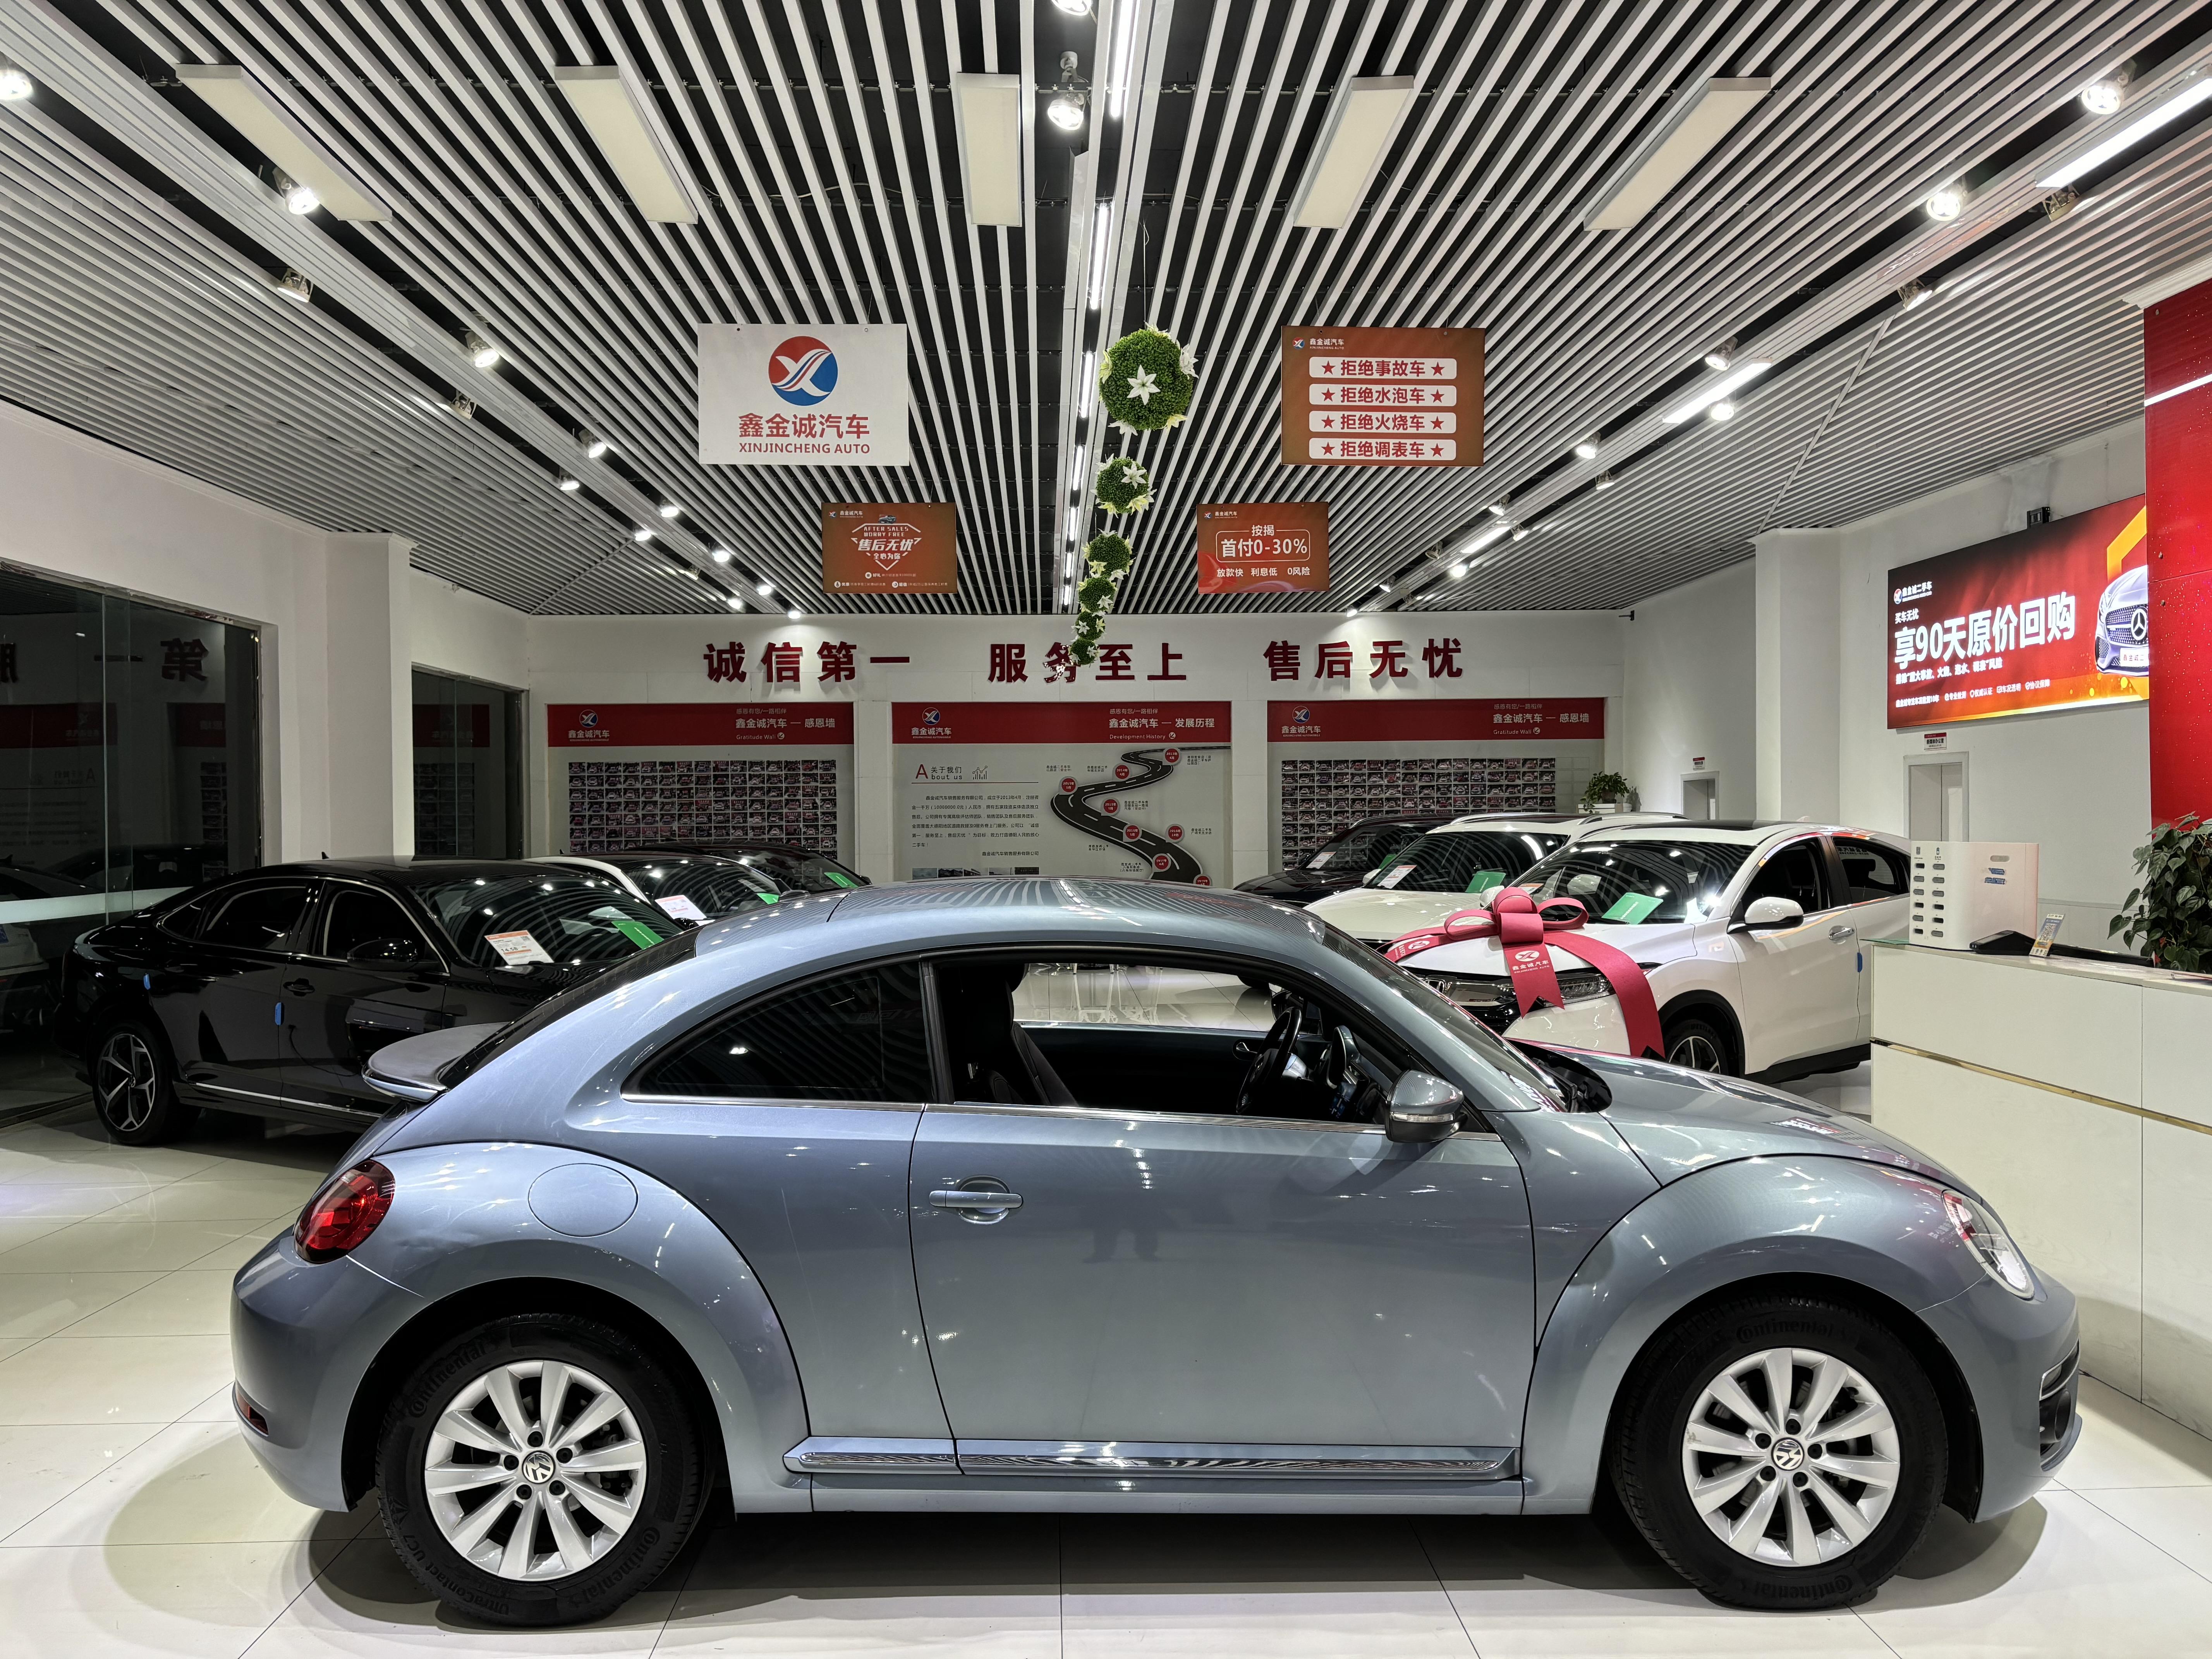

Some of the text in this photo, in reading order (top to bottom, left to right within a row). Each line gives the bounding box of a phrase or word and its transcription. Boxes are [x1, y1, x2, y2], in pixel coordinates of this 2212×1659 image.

[1341, 359, 1425, 377] 拒绝事故车
[1341, 387, 1425, 404] 拒绝水泡车
[738, 412, 870, 439] 鑫金诚汽车
[1341, 414, 1425, 431] 拒绝火烧车
[739, 443, 870, 454] XINJINCHENG AUTO
[1341, 441, 1425, 458] 拒绝调表车
[1252, 525, 1274, 536] 按揭
[858, 539, 914, 551] 售后无忧
[1221, 538, 1307, 557] 首付0-30%
[1217, 567, 1310, 577] 放款快 利息低 0风险
[1895, 608, 1919, 624] 买车无忧
[1894, 591, 2075, 670] 享90天原价回购
[703, 638, 1462, 683] 诚信第一 服务至上 售后无忧
[735, 718, 787, 728] 鑫金诚汽车
[805, 718, 835, 728] 感恩墙
[1109, 718, 1158, 728] 鑫金诚汽车
[1175, 718, 1214, 728] 发展历程
[1493, 713, 1543, 723] 鑫金诚汽车
[1559, 713, 1589, 723] 感恩墙
[568, 730, 610, 738] 鑫金诚汽车
[911, 727, 951, 735] 鑫金诚汽车
[1512, 960, 1549, 970] 鑫金诚汽车
[1736, 1318, 1834, 1343] Continental
[409, 1338, 487, 1418] Continental
[584, 1527, 660, 1604] Continental
[403, 1535, 510, 1615] UltraContact UC7
[1755, 1575, 1853, 1600] Continental
